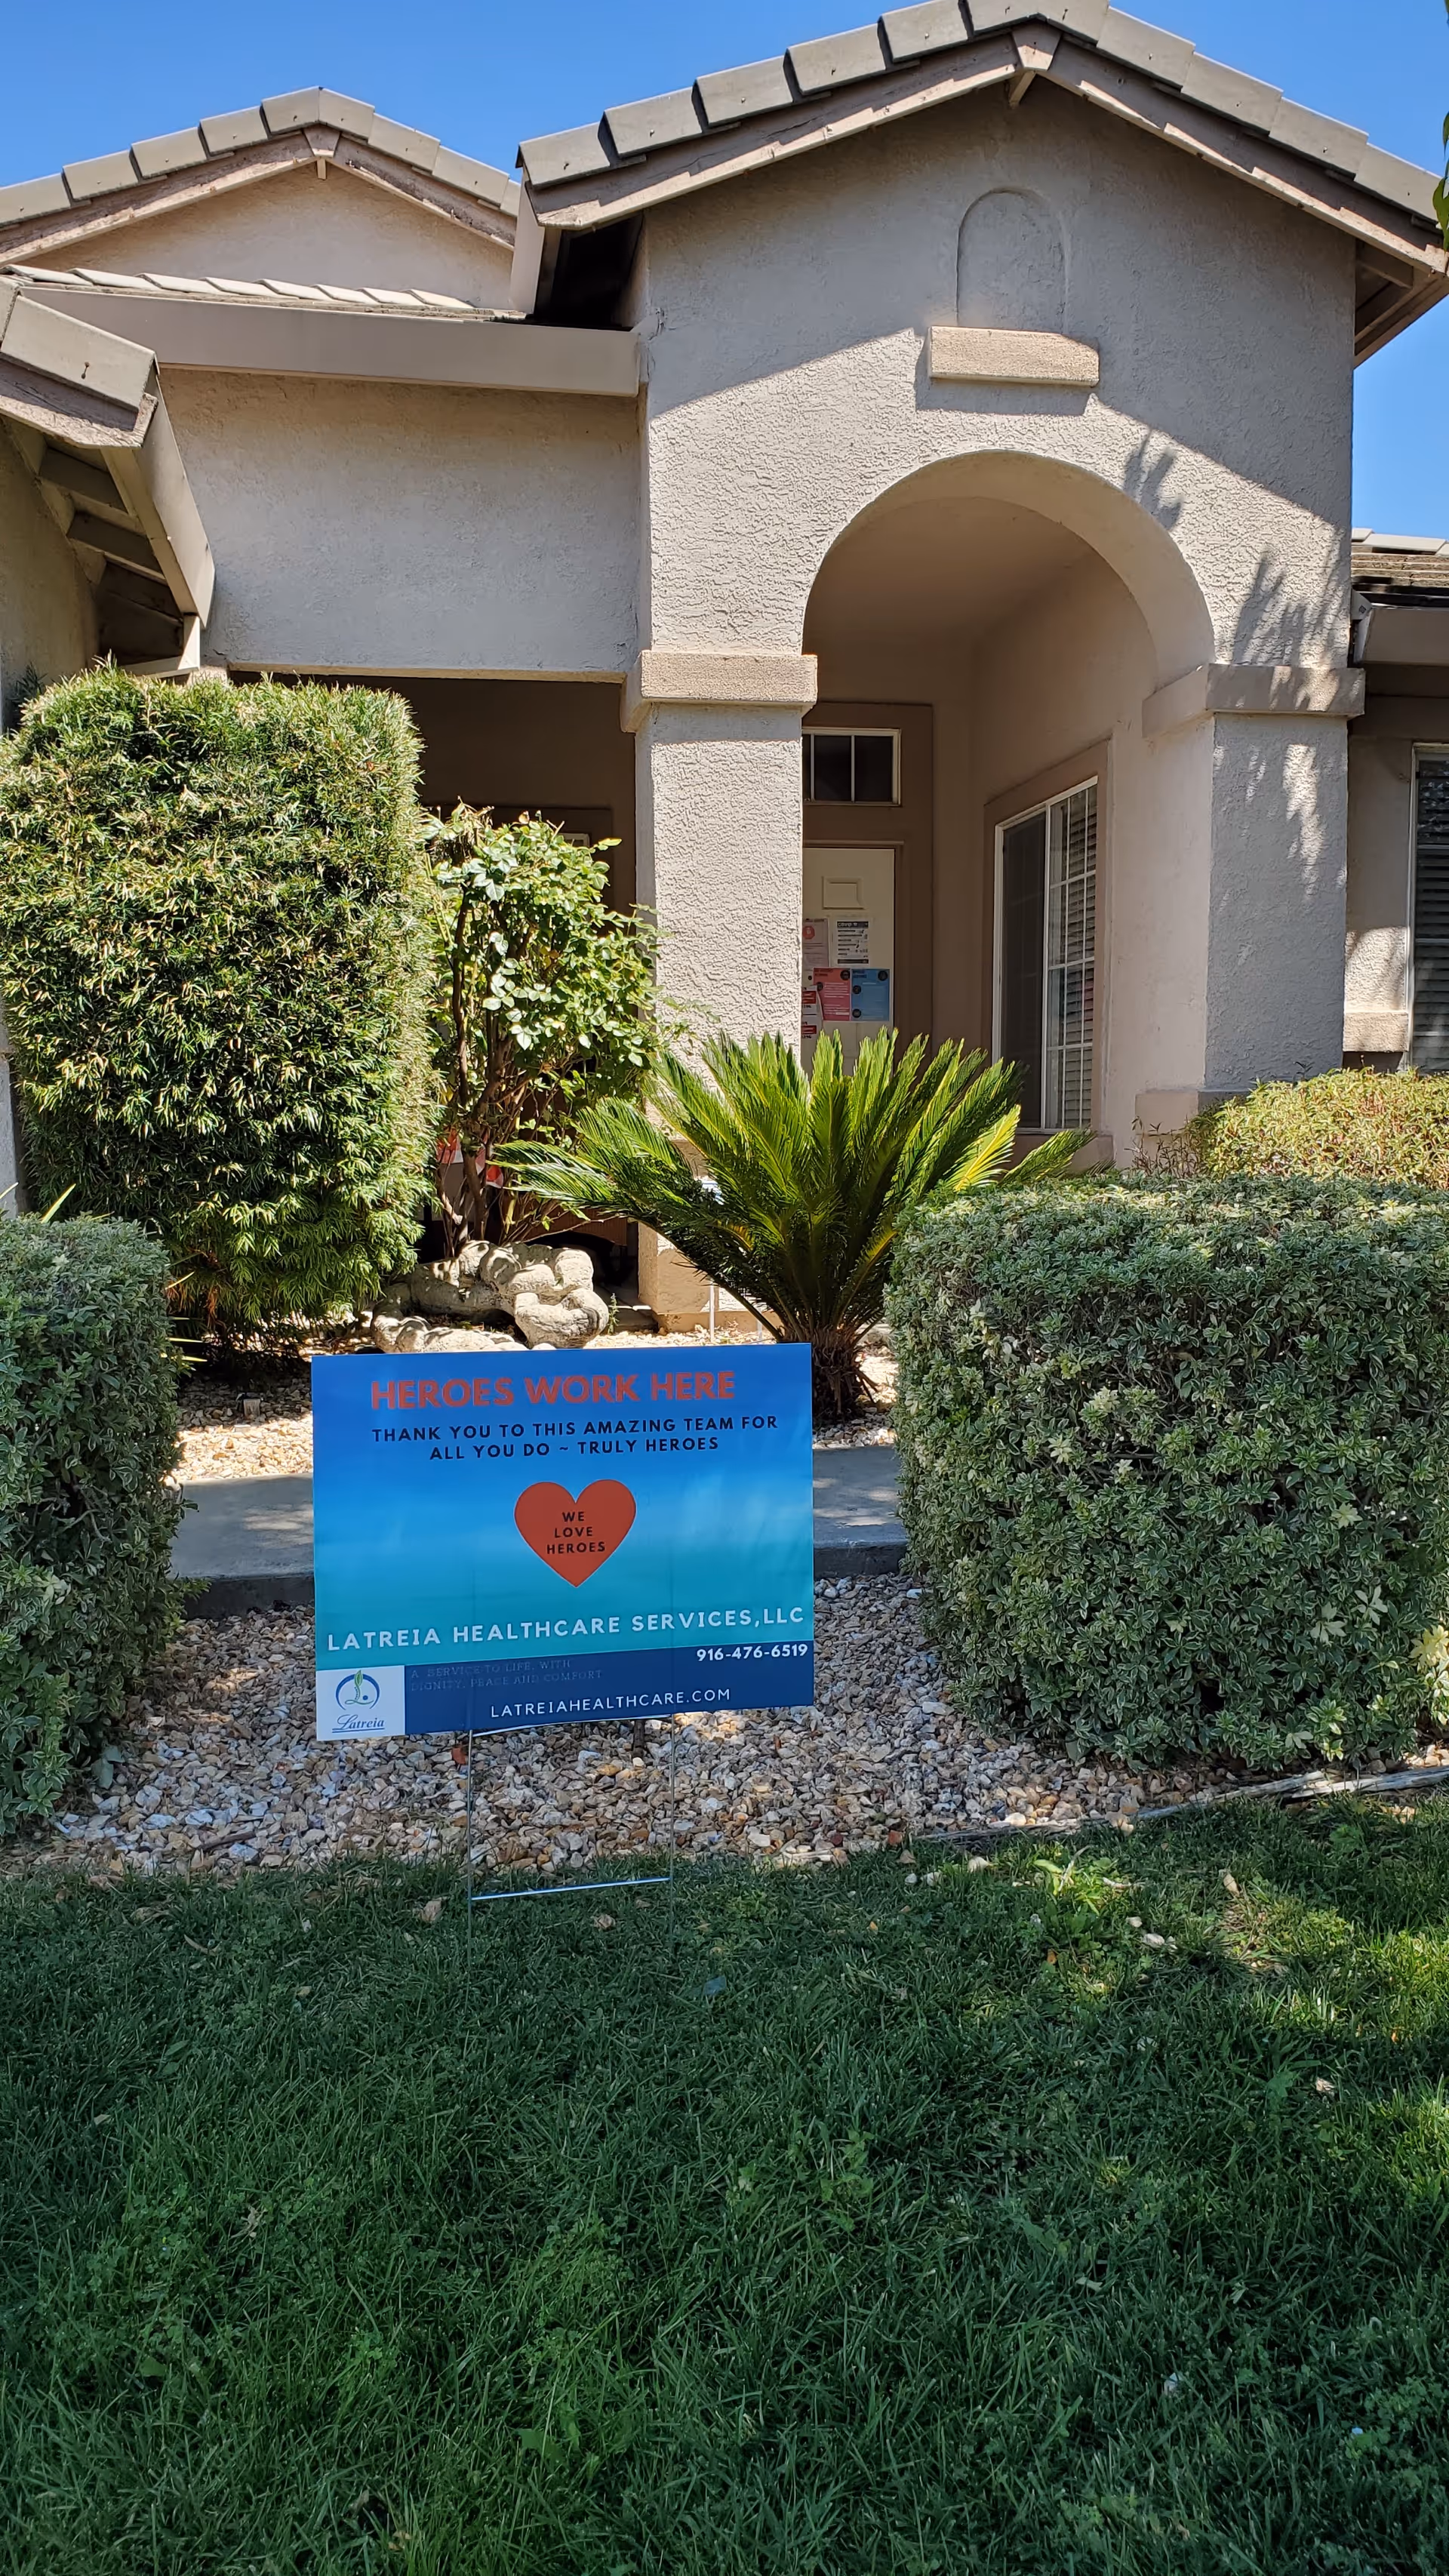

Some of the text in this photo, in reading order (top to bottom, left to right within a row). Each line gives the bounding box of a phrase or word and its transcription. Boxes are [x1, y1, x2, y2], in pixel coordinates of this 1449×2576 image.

[371, 1371, 735, 1410] HEROES WORK HERE
[372, 1415, 777, 1442] THANK YOU TO THIS AMAZING TEAM FOR
[429, 1445, 465, 1460] ALL
[473, 1444, 515, 1458] YOU
[523, 1442, 550, 1457] DO
[577, 1439, 638, 1454] TRULY
[645, 1436, 718, 1452] HEROES
[562, 1511, 584, 1522] WE
[554, 1526, 592, 1538] LOVE
[546, 1541, 605, 1555] HEROES
[328, 1628, 441, 1651] LATREIA
[453, 1616, 620, 1643] HEALTHCARE
[697, 1643, 808, 1661] 916-476-6519
[411, 1670, 419, 1679] A
[427, 1665, 481, 1677] SERVICE
[485, 1664, 500, 1673] TO
[471, 1676, 509, 1688] PEACE
[514, 1674, 538, 1685] AND
[544, 1670, 602, 1682] COMFORT
[491, 1688, 731, 1718] LATREIAHEALTHCARE.COM
[332, 1714, 385, 1731] Latreia
